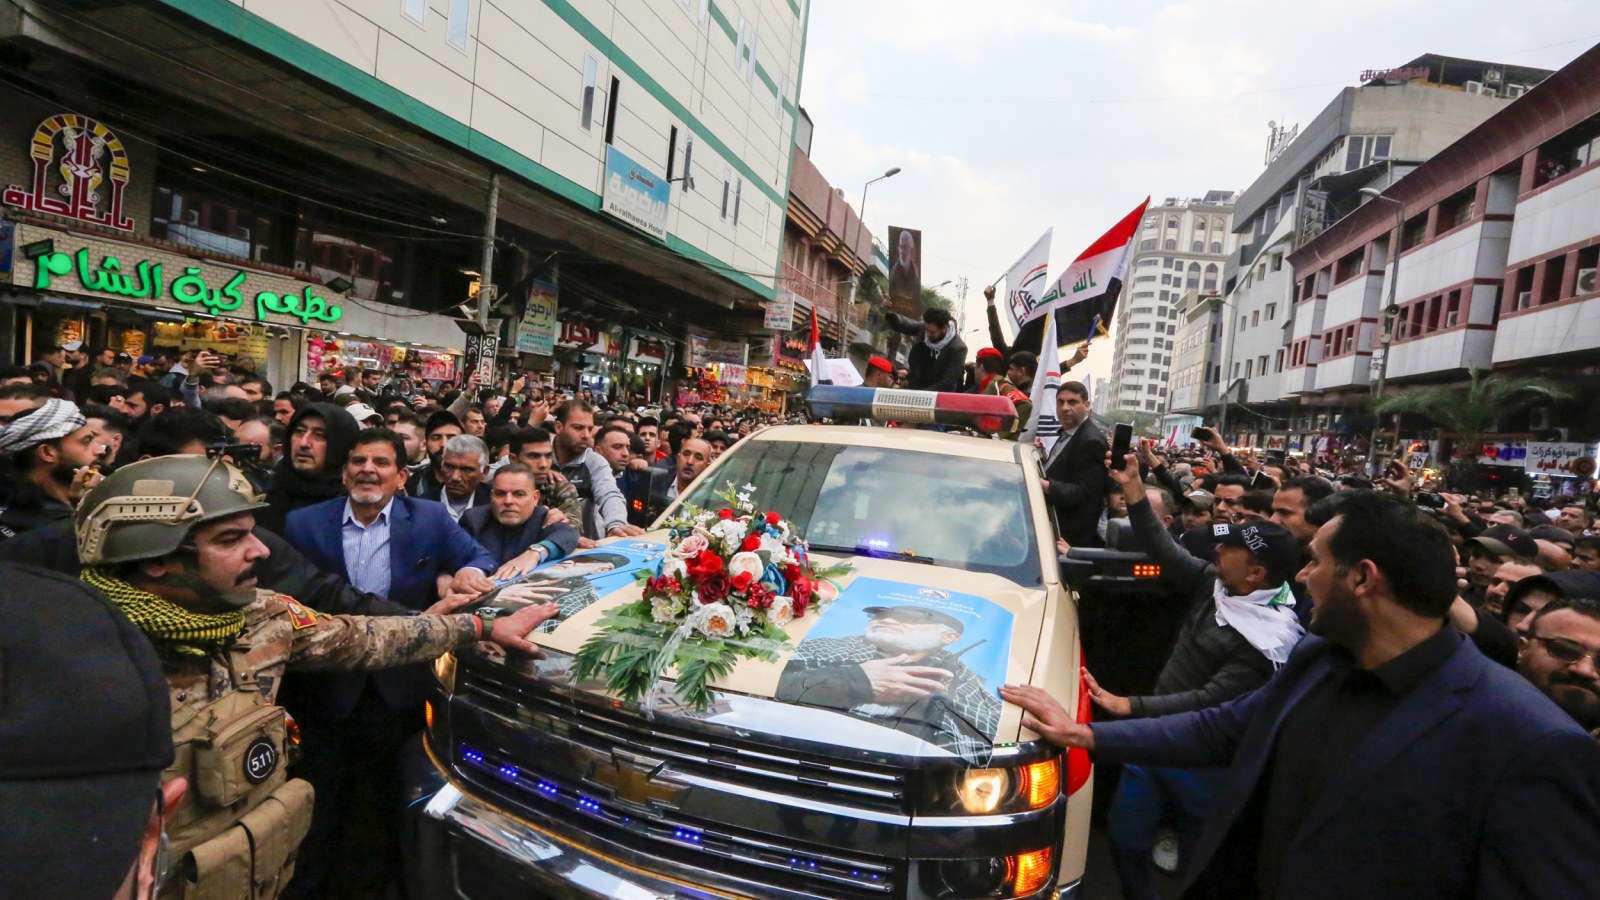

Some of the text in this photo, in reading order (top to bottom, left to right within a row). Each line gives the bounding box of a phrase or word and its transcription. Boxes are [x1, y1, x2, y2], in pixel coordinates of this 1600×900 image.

[609, 172, 667, 221] الرضوية
[648, 221, 664, 236] Hotel
[36, 248, 343, 324] مطعم كبة الشام
[1072, 268, 1097, 293] الله
[1556, 446, 1582, 459] اسواق
[1241, 526, 1268, 551] 5.11
[251, 750, 272, 772] 5.11
